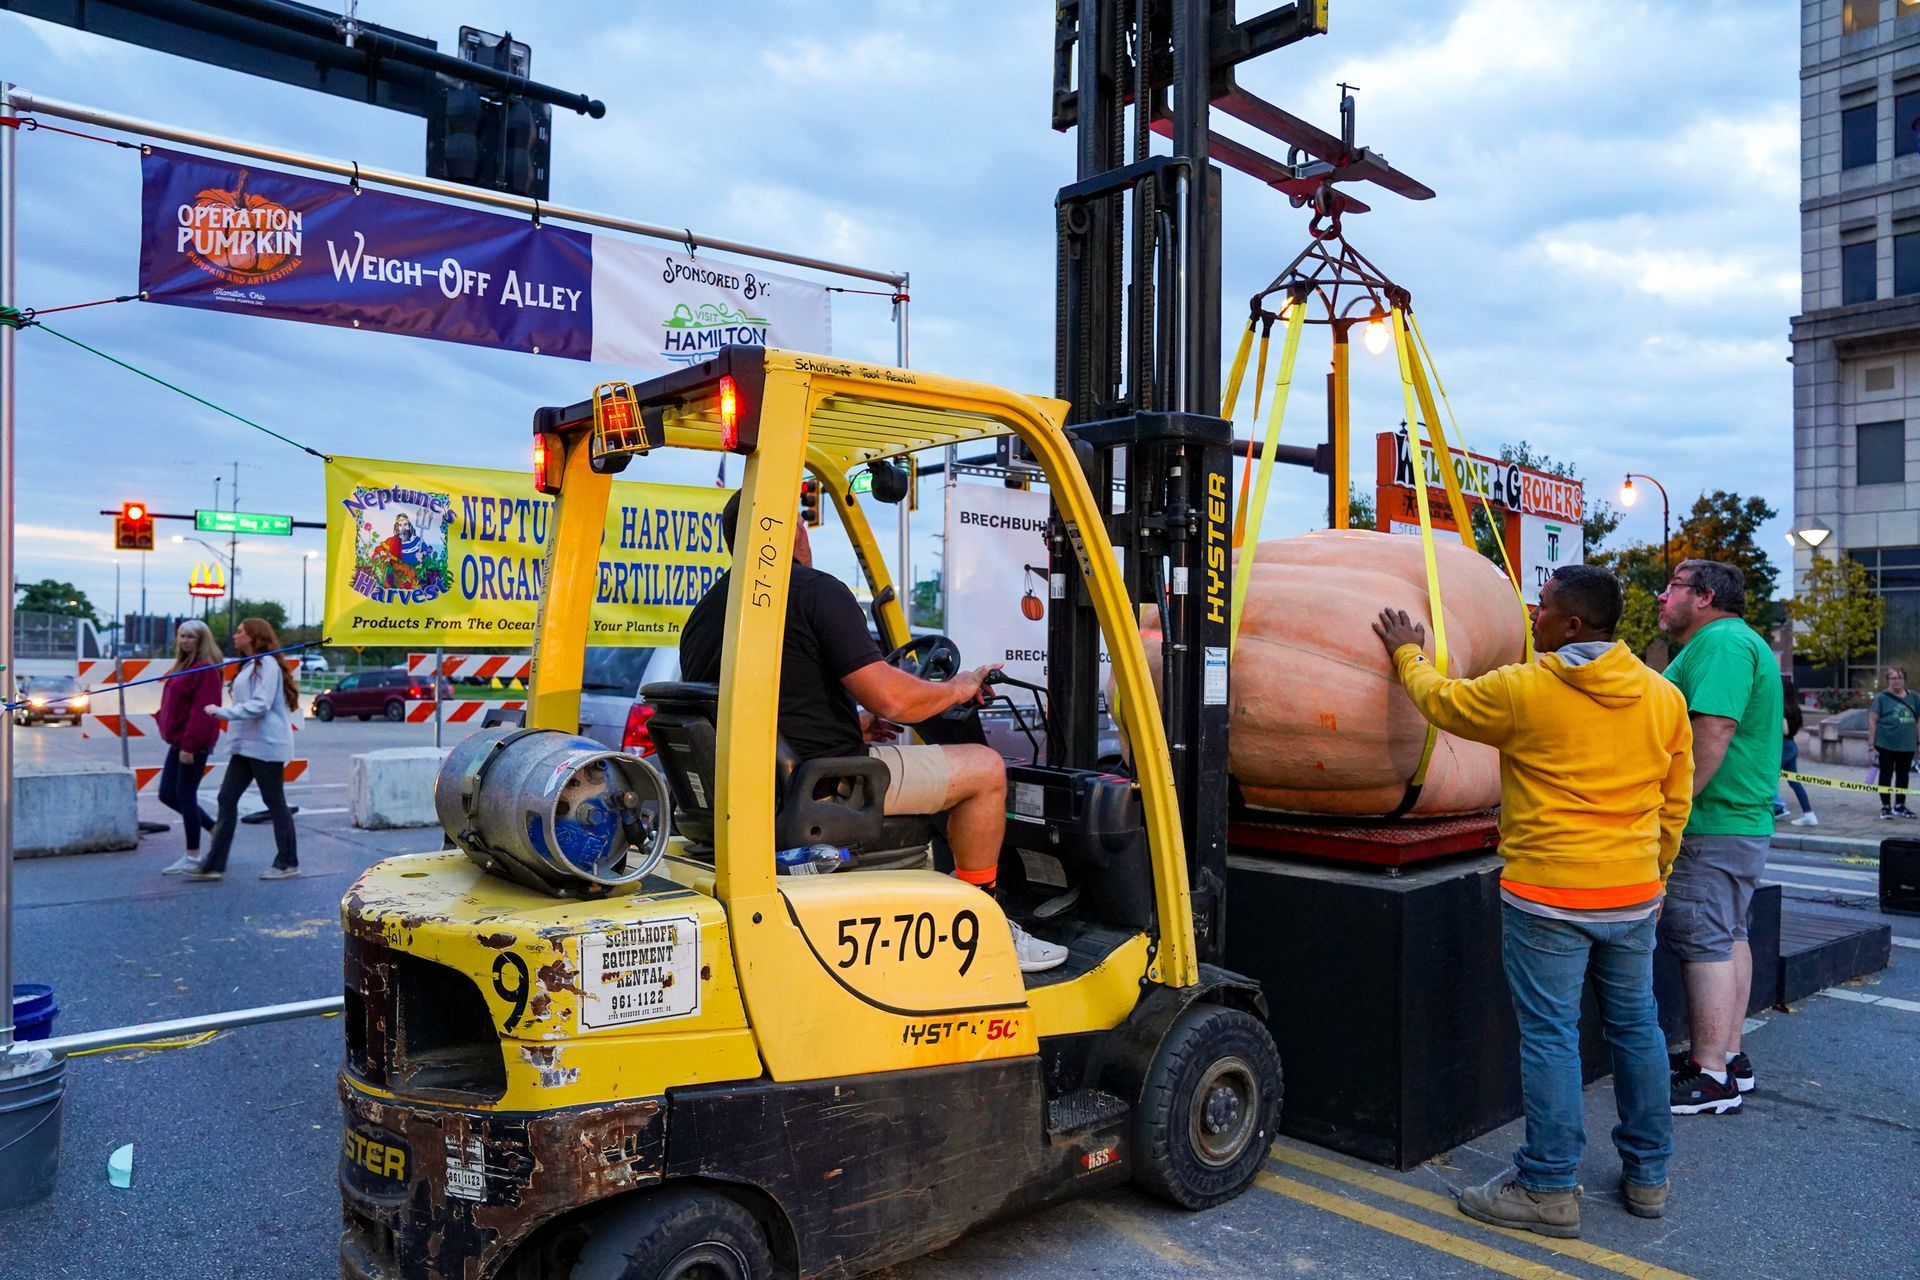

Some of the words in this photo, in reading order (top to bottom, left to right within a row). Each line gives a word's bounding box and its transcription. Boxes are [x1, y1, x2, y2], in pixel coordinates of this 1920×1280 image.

[178, 204, 302, 230] OPERATION
[177, 227, 302, 256] PUMPKIN
[187, 251, 225, 279] PUMPKIN
[227, 275, 245, 285] AND
[247, 276, 264, 285] ART
[266, 258, 303, 283] FESTIVAL
[663, 257, 740, 290] SPONSORED
[500, 270, 582, 312] ALLEY
[695, 310, 719, 322] VISIT
[665, 326, 767, 351] HAMILTON
[1395, 433, 1489, 496] WLOME
[1507, 464, 1581, 519] GROWERS
[460, 496, 605, 545] NEPTU
[620, 507, 725, 553] HARVEST
[960, 511, 1046, 533] BRECHBUH
[752, 517, 783, 607] 57-70-9
[1207, 472, 1226, 624] HYSTER
[353, 570, 449, 605] Harvest
[461, 554, 544, 601] ORGAN
[595, 561, 725, 606] ERTILIZER
[352, 616, 420, 629] Products
[424, 617, 463, 630] From
[467, 618, 493, 630] The
[594, 620, 623, 632] Your
[626, 621, 664, 633] Plants
[668, 622, 680, 633] In
[1796, 774, 1832, 787] CAUTION
[1839, 781, 1879, 793] CAUTION
[605, 925, 675, 948] SCHULHOFF
[838, 909, 979, 977] 57-70-9
[602, 945, 674, 969] EQUIPMENT
[492, 951, 529, 1033] 9
[612, 990, 664, 1010] 961-1122
